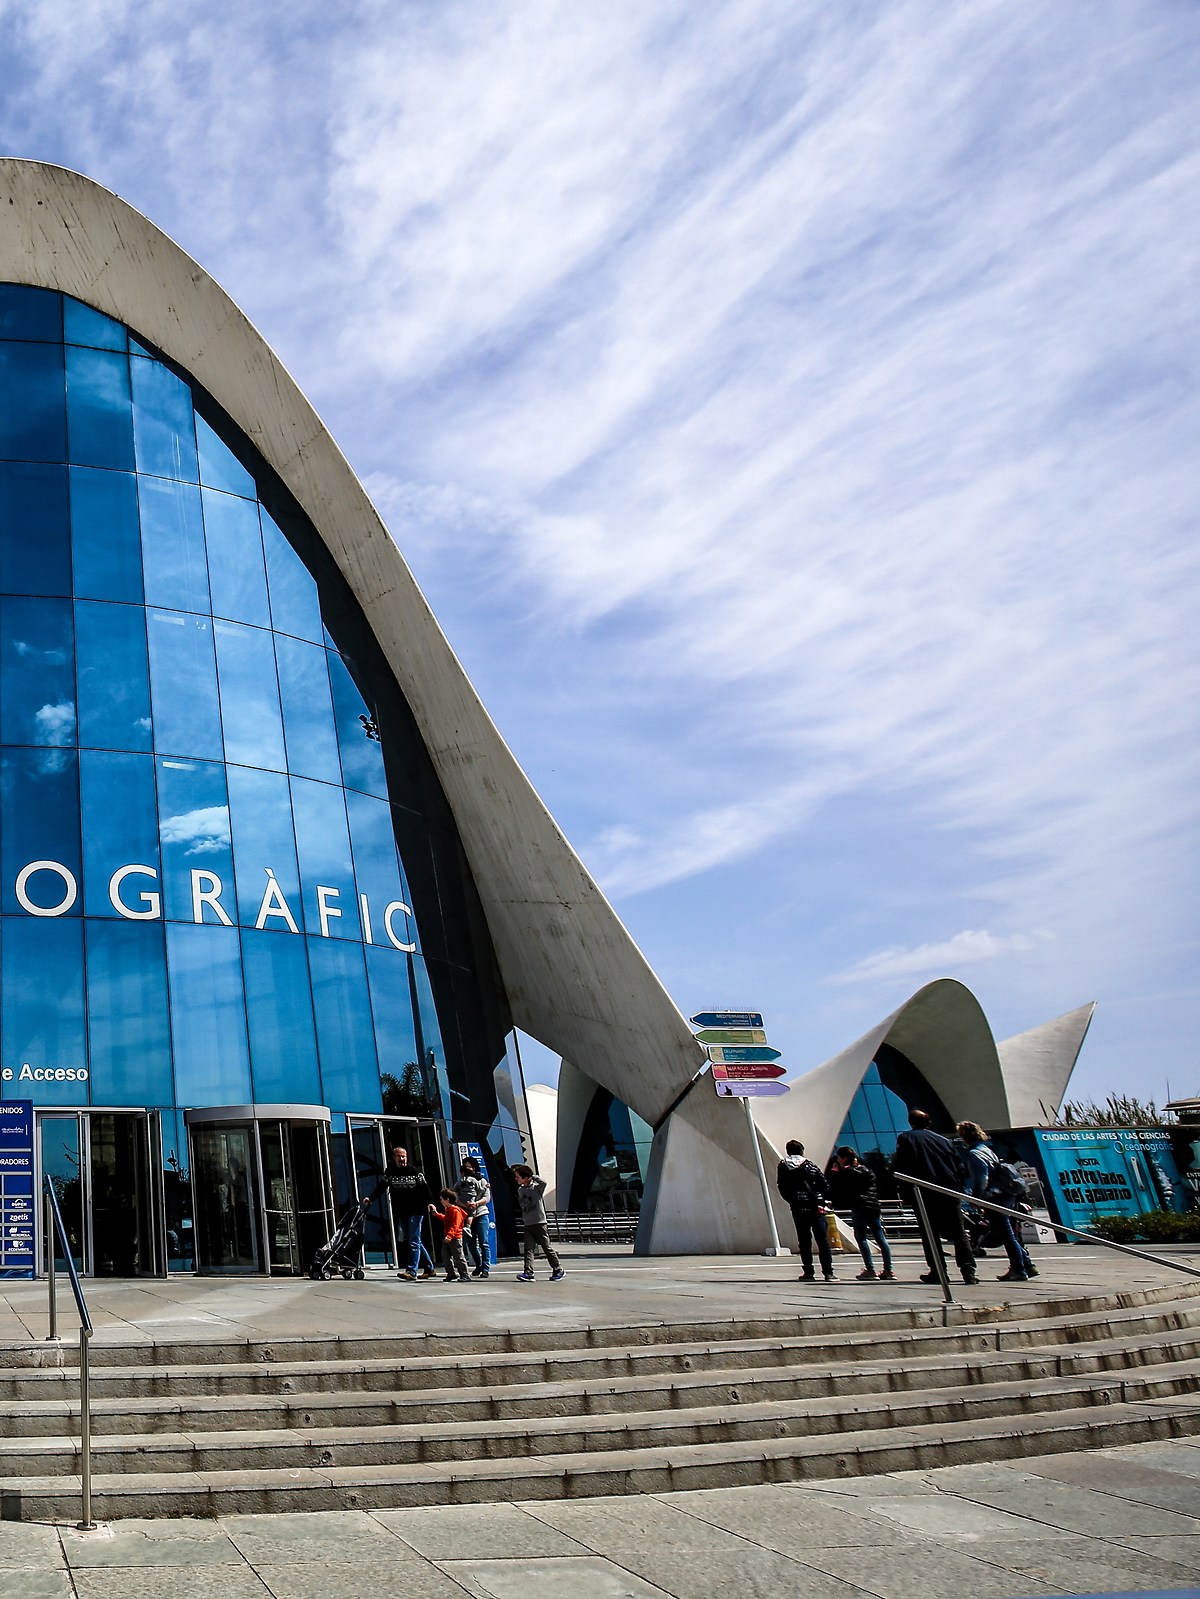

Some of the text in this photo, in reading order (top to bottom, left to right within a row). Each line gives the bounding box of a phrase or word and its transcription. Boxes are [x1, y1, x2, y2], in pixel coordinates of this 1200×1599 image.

[19, 1064, 89, 1081] Acceso
[1041, 1133, 1070, 1141] CIUDAD
[1070, 1133, 1080, 1141] DE
[1096, 1132, 1117, 1140] ARTES
[1117, 1132, 1123, 1140] Y
[1124, 1132, 1138, 1140] LAS
[1139, 1132, 1171, 1140] CIENCIAS
[1075, 1158, 1100, 1166] VISITA
[9, 1213, 29, 1222] zoetis
